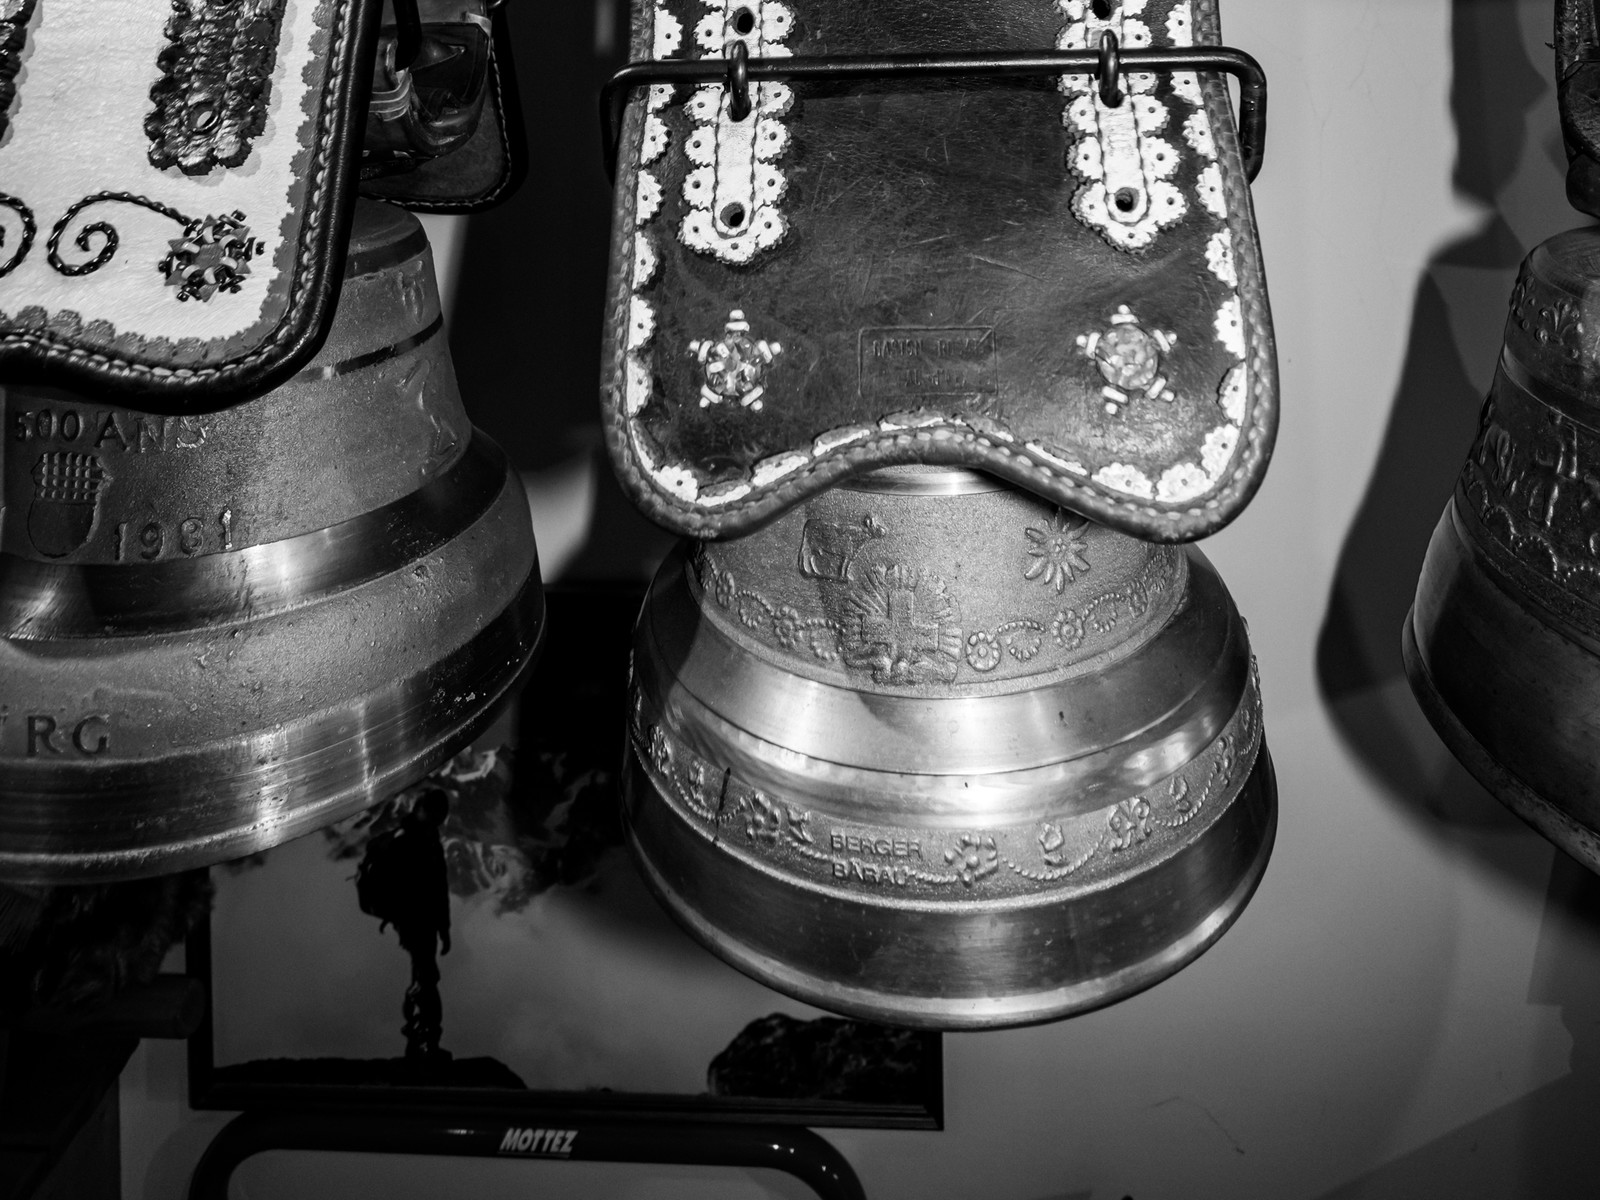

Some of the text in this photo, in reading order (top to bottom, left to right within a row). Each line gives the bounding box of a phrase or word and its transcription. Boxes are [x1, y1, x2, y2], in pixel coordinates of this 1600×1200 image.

[94, 410, 208, 453] ANS
[830, 829, 923, 860] BERGER
[499, 1127, 579, 1153] MOTTEZ
